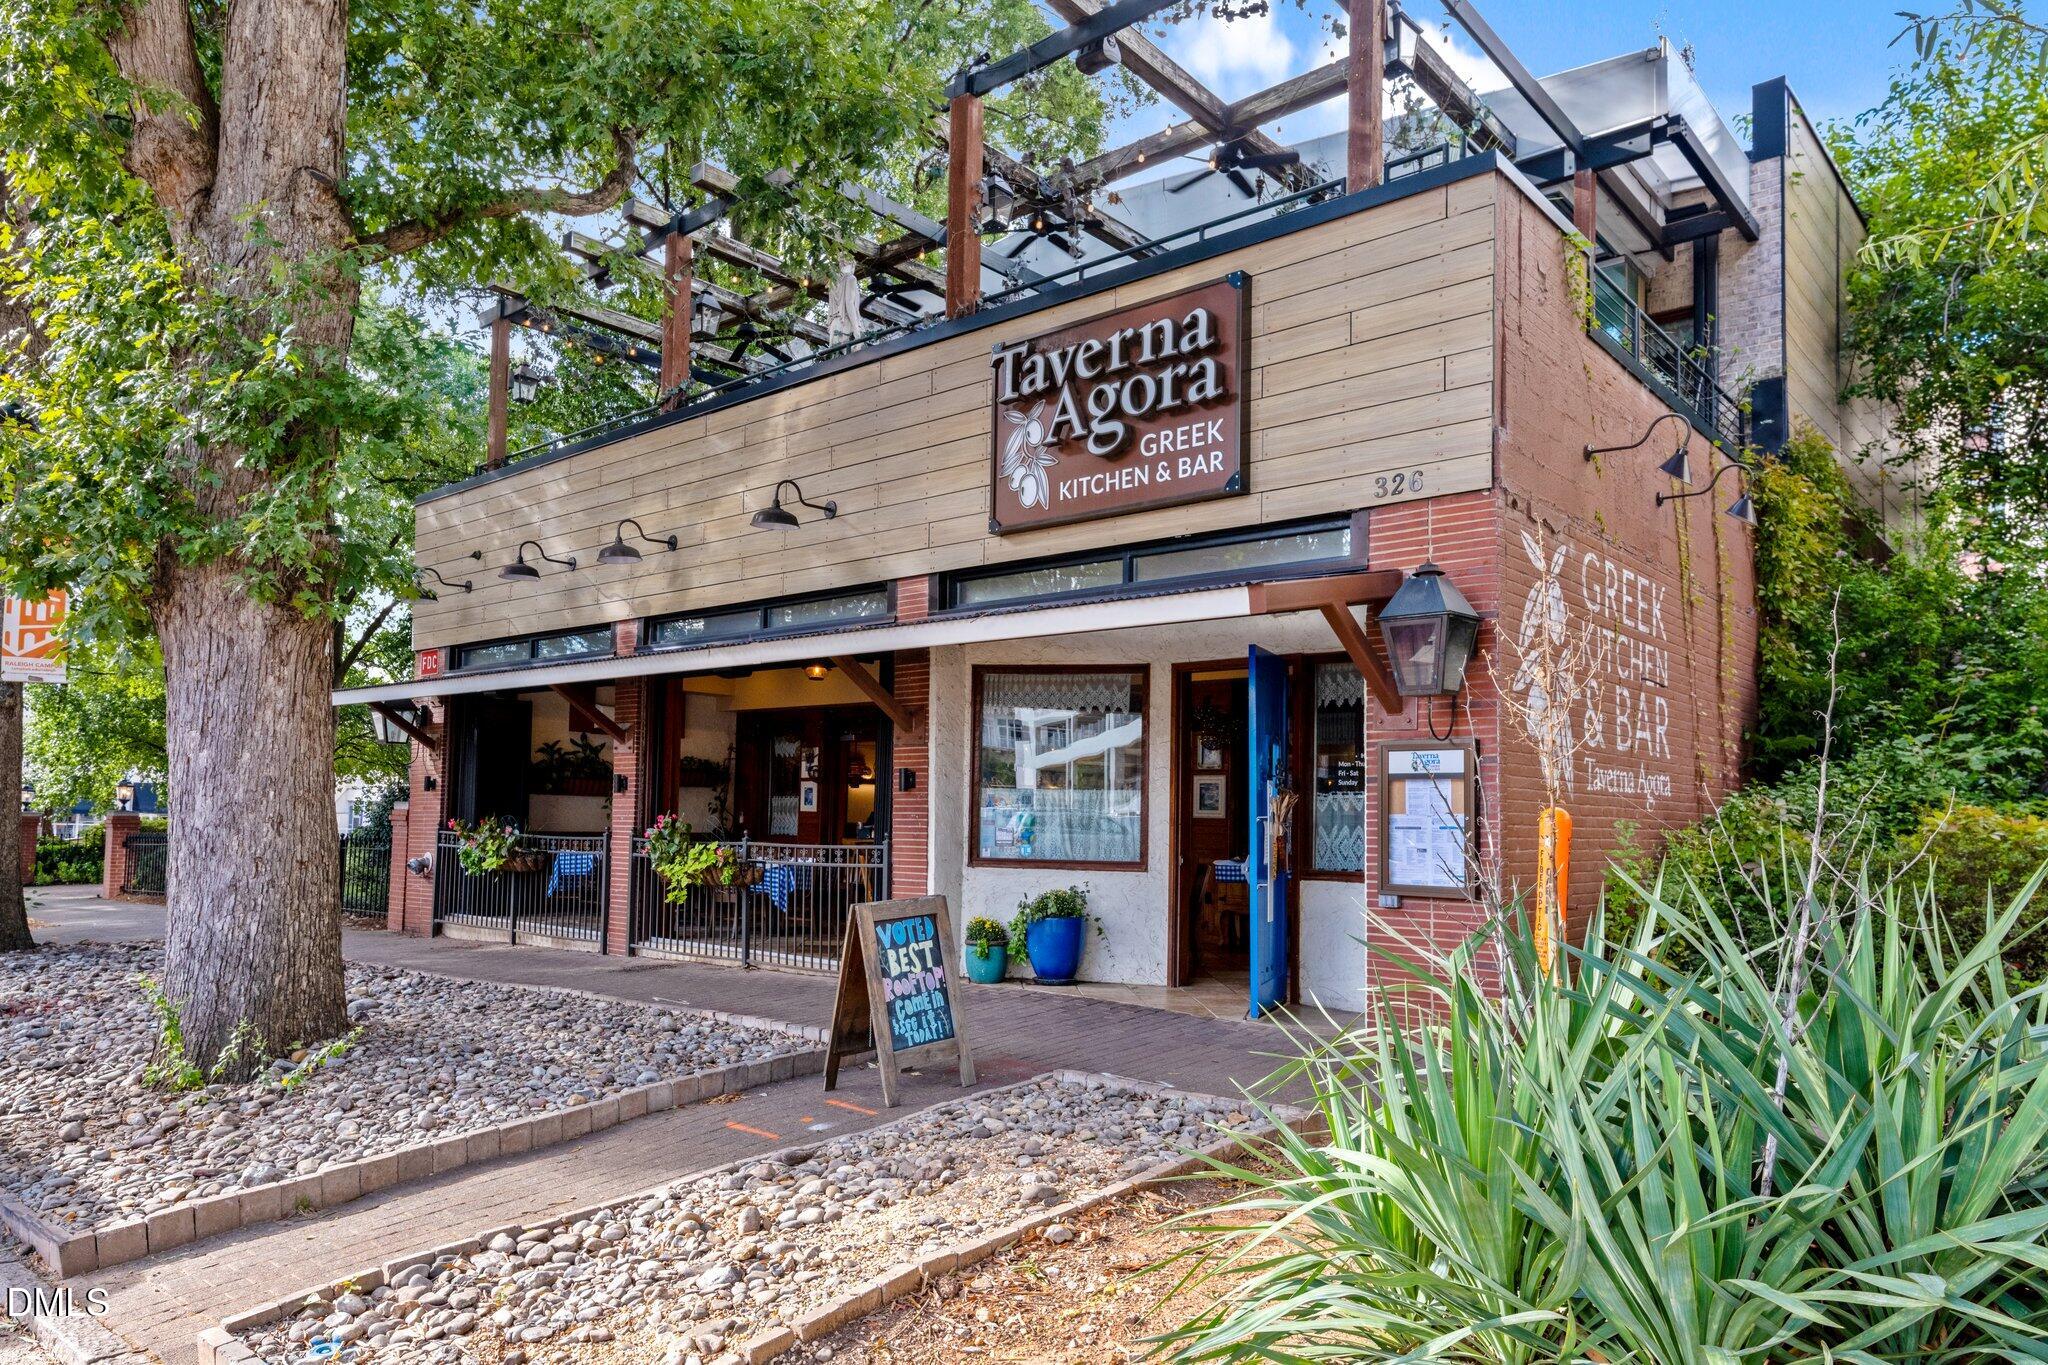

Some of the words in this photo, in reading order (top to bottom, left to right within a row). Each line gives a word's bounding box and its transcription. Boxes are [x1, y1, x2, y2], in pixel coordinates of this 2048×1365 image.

[991, 307, 1217, 402] Taverna
[1042, 355, 1224, 456] Agora
[1140, 418, 1224, 457] GREEK
[1059, 465, 1150, 501] KITCHEN
[1155, 461, 1173, 482] &
[1178, 450, 1224, 477] BAR
[1374, 470, 1424, 498] 326
[1582, 552, 1667, 641] GREEK
[5, 660, 34, 668] RALEIGH
[422, 654, 438, 670] FDC
[1582, 620, 1668, 688] KITCHEN
[1584, 679, 1606, 748] &
[1616, 685, 1671, 759] BAR
[1584, 757, 1635, 793] Taverna
[1637, 762, 1672, 812] Agora
[876, 916, 934, 949] VOTED
[887, 940, 933, 977] BEST
[883, 966, 947, 1002] ROOFTOP!
[904, 1020, 944, 1046] TODAY!
